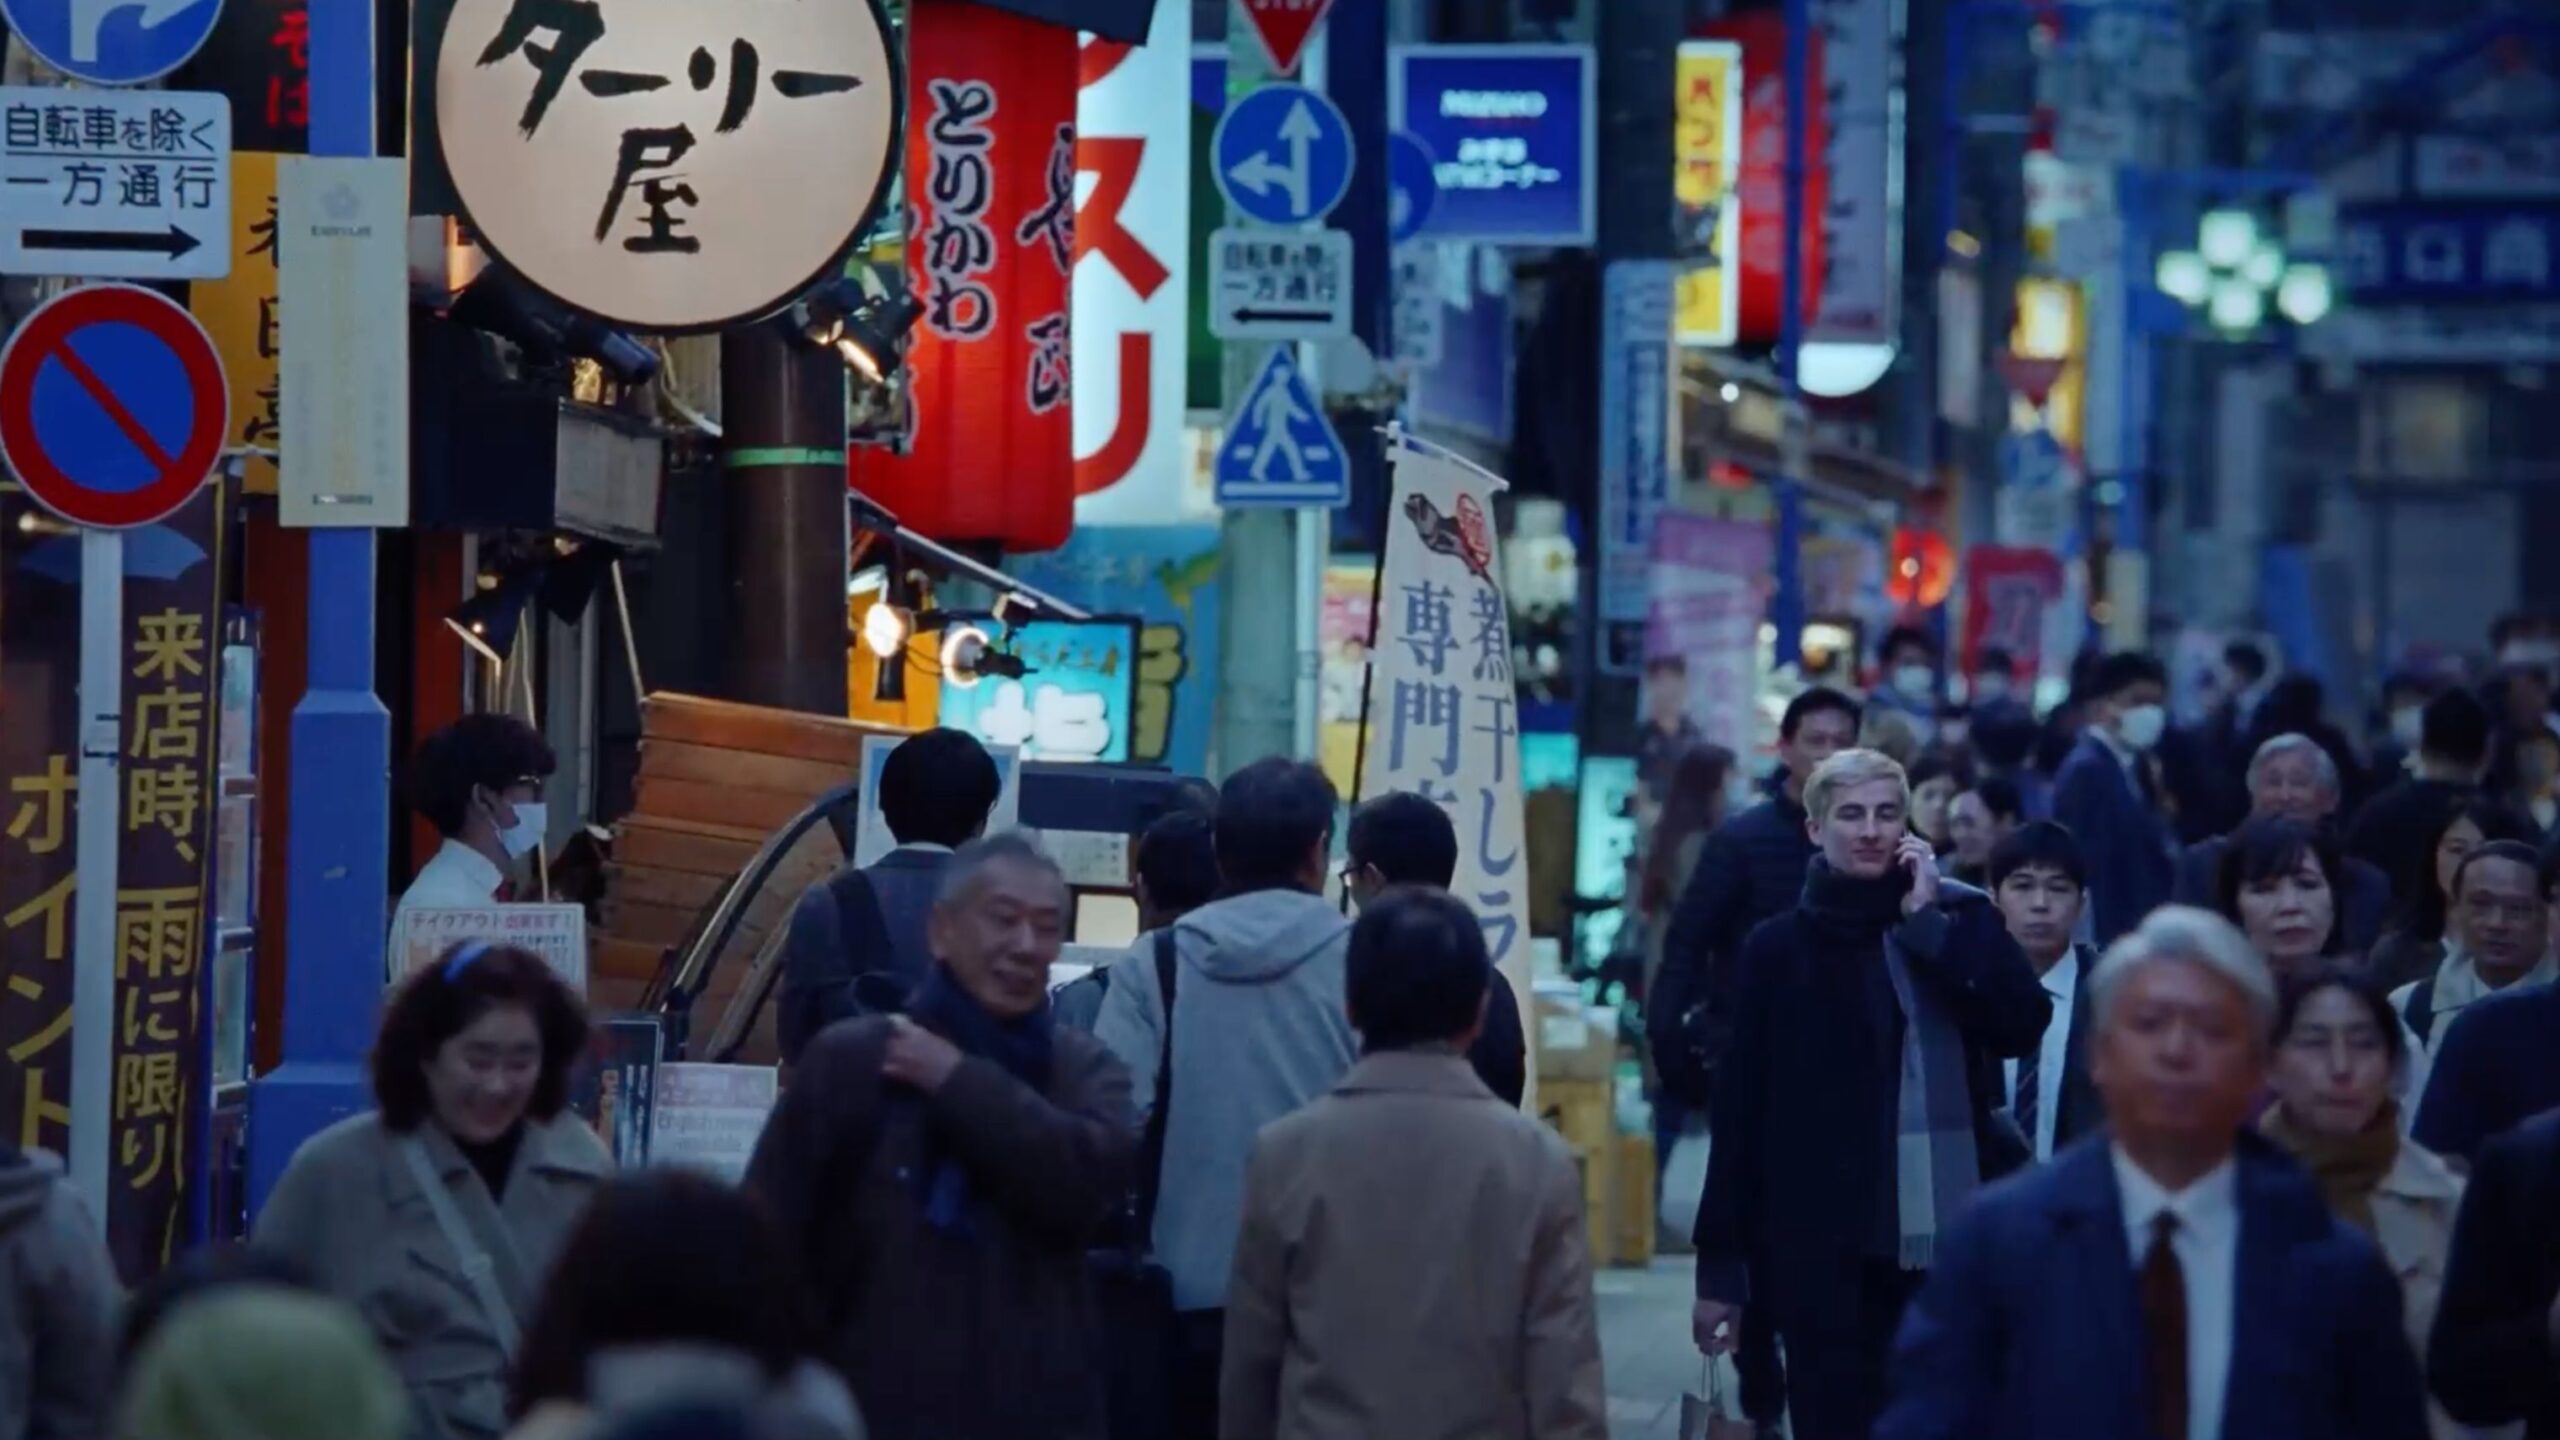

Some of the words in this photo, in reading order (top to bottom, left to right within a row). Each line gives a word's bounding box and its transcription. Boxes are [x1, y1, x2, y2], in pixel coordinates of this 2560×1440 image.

[6, 103, 216, 153] 自転車を除く
[476, 0, 863, 140] ターリー
[6, 164, 218, 210] 一方通行
[594, 123, 700, 254] 屋
[930, 82, 993, 336] とりかわ
[1075, 38, 1170, 496] スリ
[1388, 580, 1462, 803] 専門
[115, 608, 204, 1190] 来店時、雨に限り
